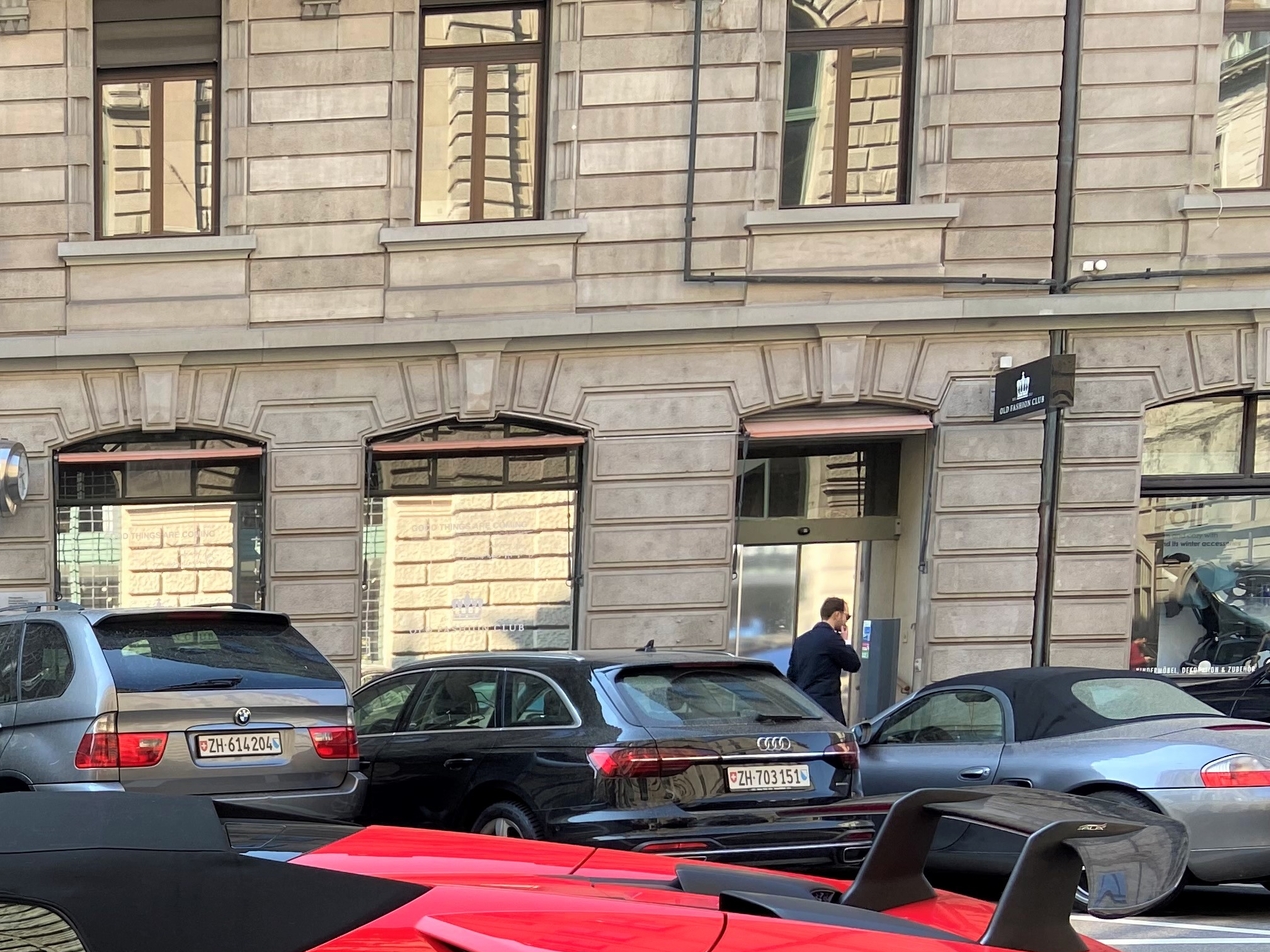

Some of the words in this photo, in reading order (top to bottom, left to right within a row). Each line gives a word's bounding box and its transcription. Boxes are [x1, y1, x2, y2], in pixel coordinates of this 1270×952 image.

[999, 406, 1009, 415] OLD
[1010, 400, 1031, 412] FASHION
[1031, 396, 1045, 405] CLUB
[439, 522, 471, 531] THINGS
[493, 623, 525, 631] CLUB
